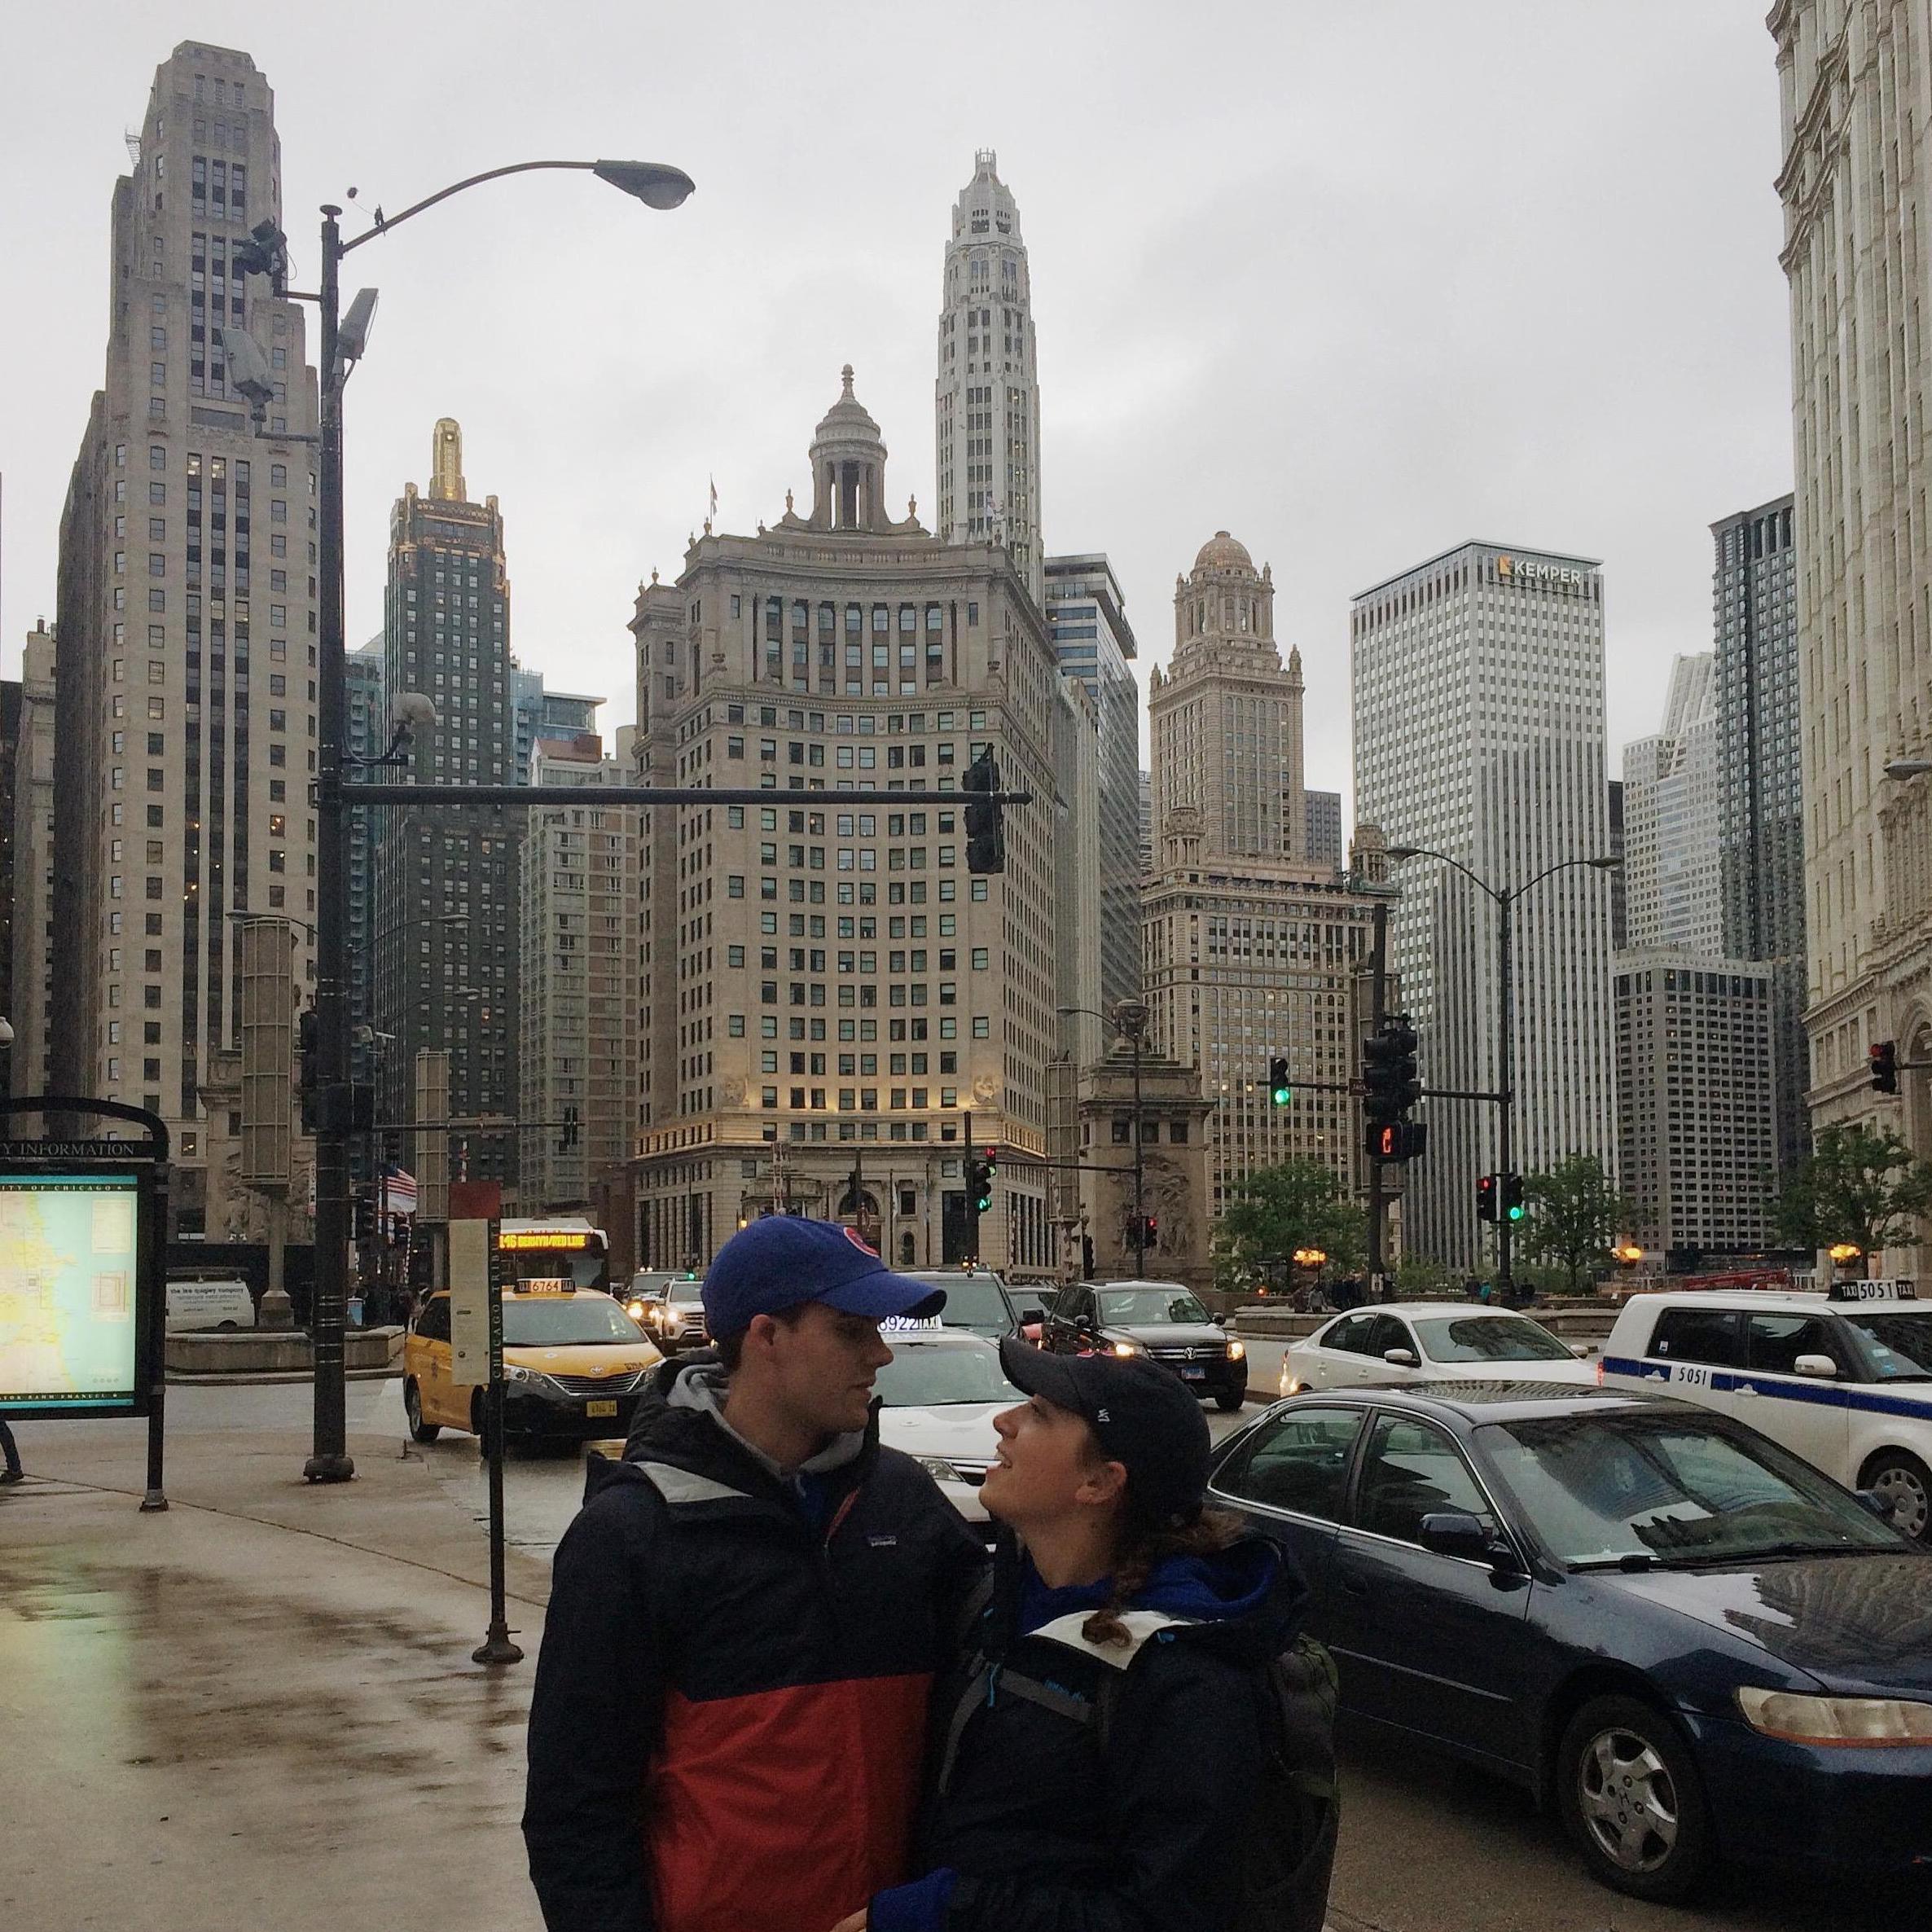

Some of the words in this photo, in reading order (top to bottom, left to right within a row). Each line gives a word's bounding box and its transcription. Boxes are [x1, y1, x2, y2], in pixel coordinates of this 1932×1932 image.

[1514, 560, 1581, 584] KEMPER
[2, 1143, 13, 1155] Y
[20, 1143, 134, 1156] INFORMATION
[499, 1234, 517, 1249] 146
[568, 1235, 586, 1247] LINE
[532, 1280, 559, 1292] 6764
[1842, 1285, 1858, 1297] TAXI
[1860, 1282, 1893, 1299] 5051
[1898, 1284, 1914, 1296] TAXI
[492, 1304, 501, 1378] CHICAGO
[1679, 1367, 1707, 1385] 5051
